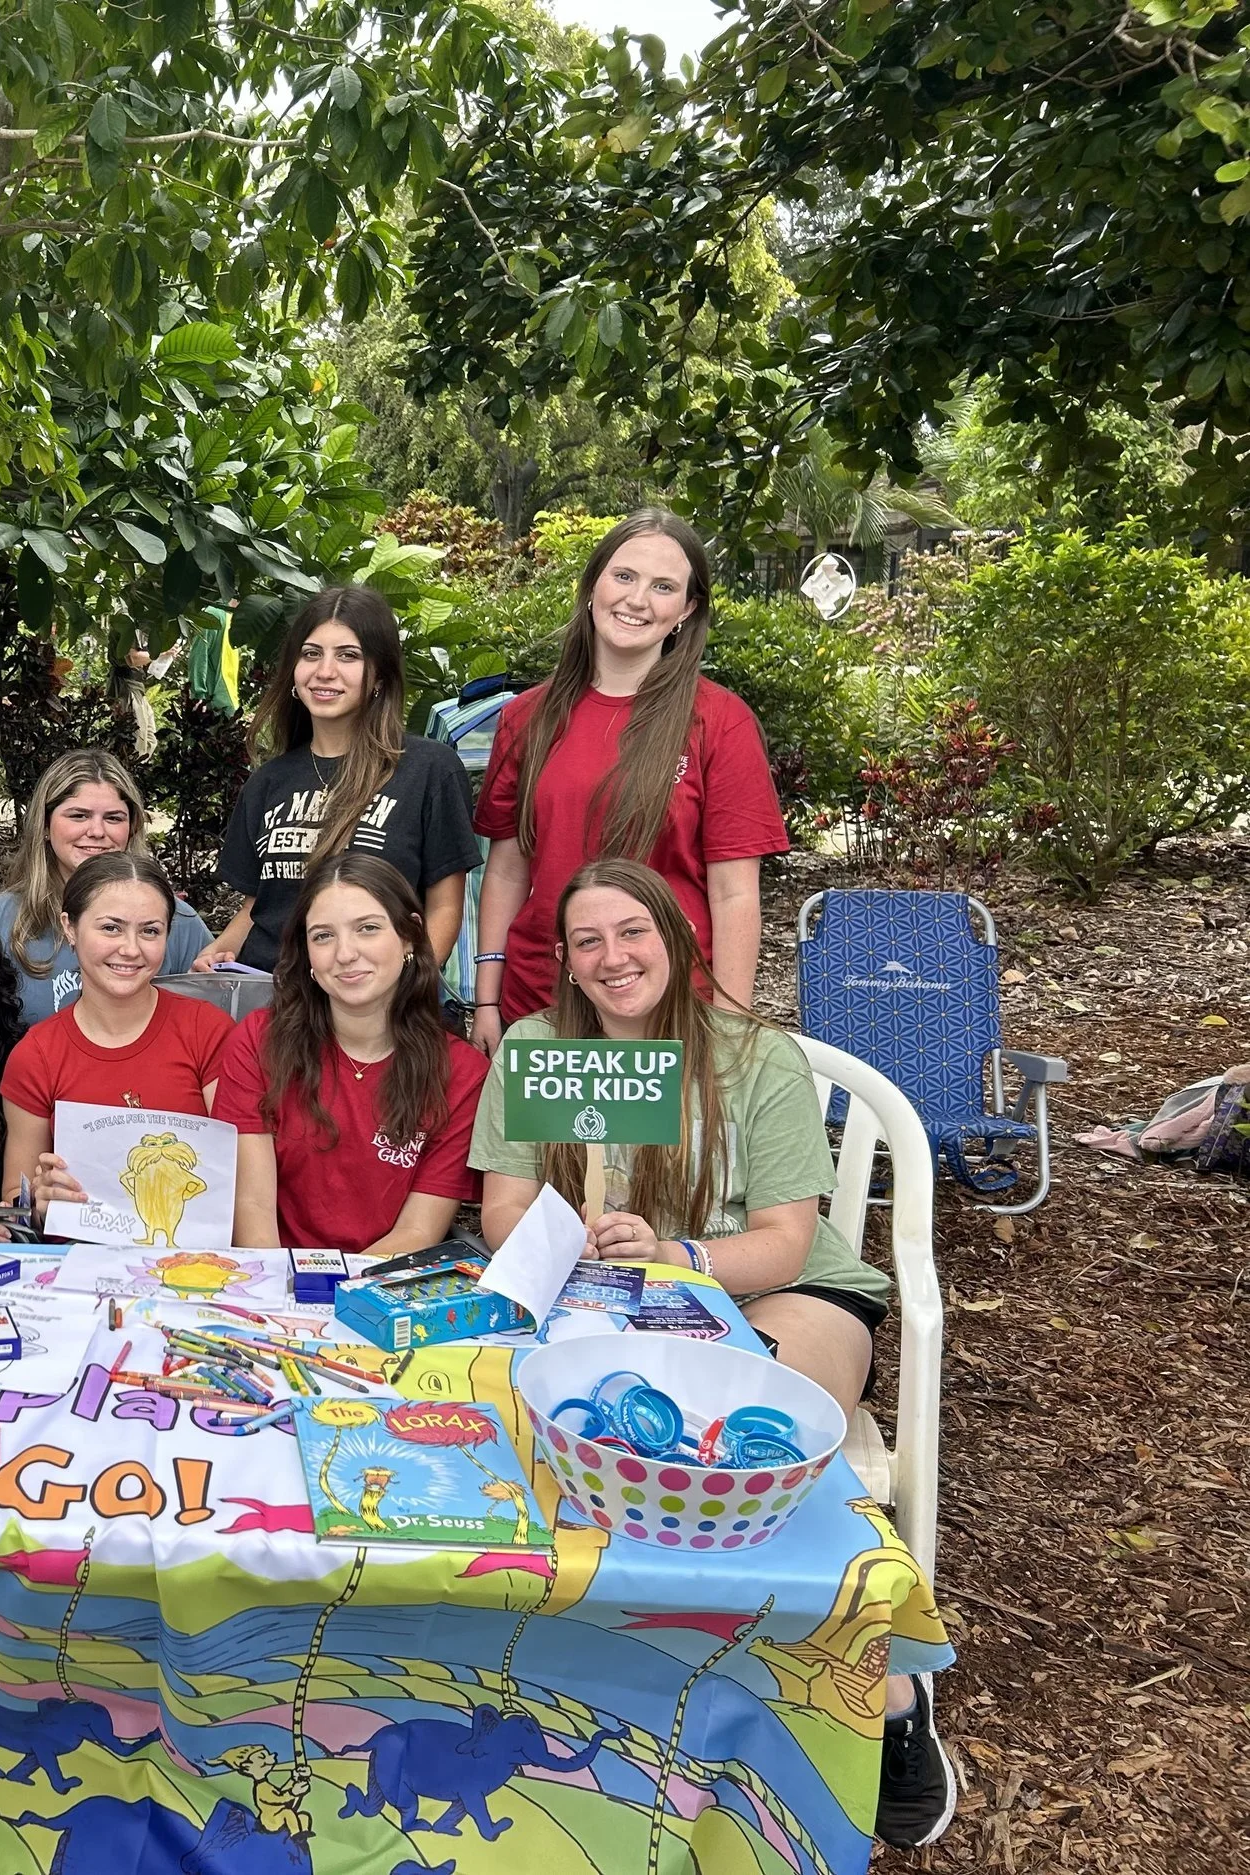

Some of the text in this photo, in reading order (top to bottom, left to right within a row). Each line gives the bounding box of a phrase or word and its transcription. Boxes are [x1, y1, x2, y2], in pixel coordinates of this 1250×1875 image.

[273, 831, 310, 848] EST.
[842, 974, 952, 992] Tommy Bahama
[510, 1049, 678, 1075] I SPEAK UP
[524, 1076, 663, 1102] FOR KIDS
[94, 1115, 125, 1130] SPEAK
[125, 1113, 145, 1124] FOR
[147, 1113, 165, 1125] THE
[377, 1147, 419, 1169] GLASS
[79, 1208, 136, 1234] LORAX
[326, 1406, 488, 1434] The LORAX
[389, 1514, 486, 1531] Dr. Seuss
